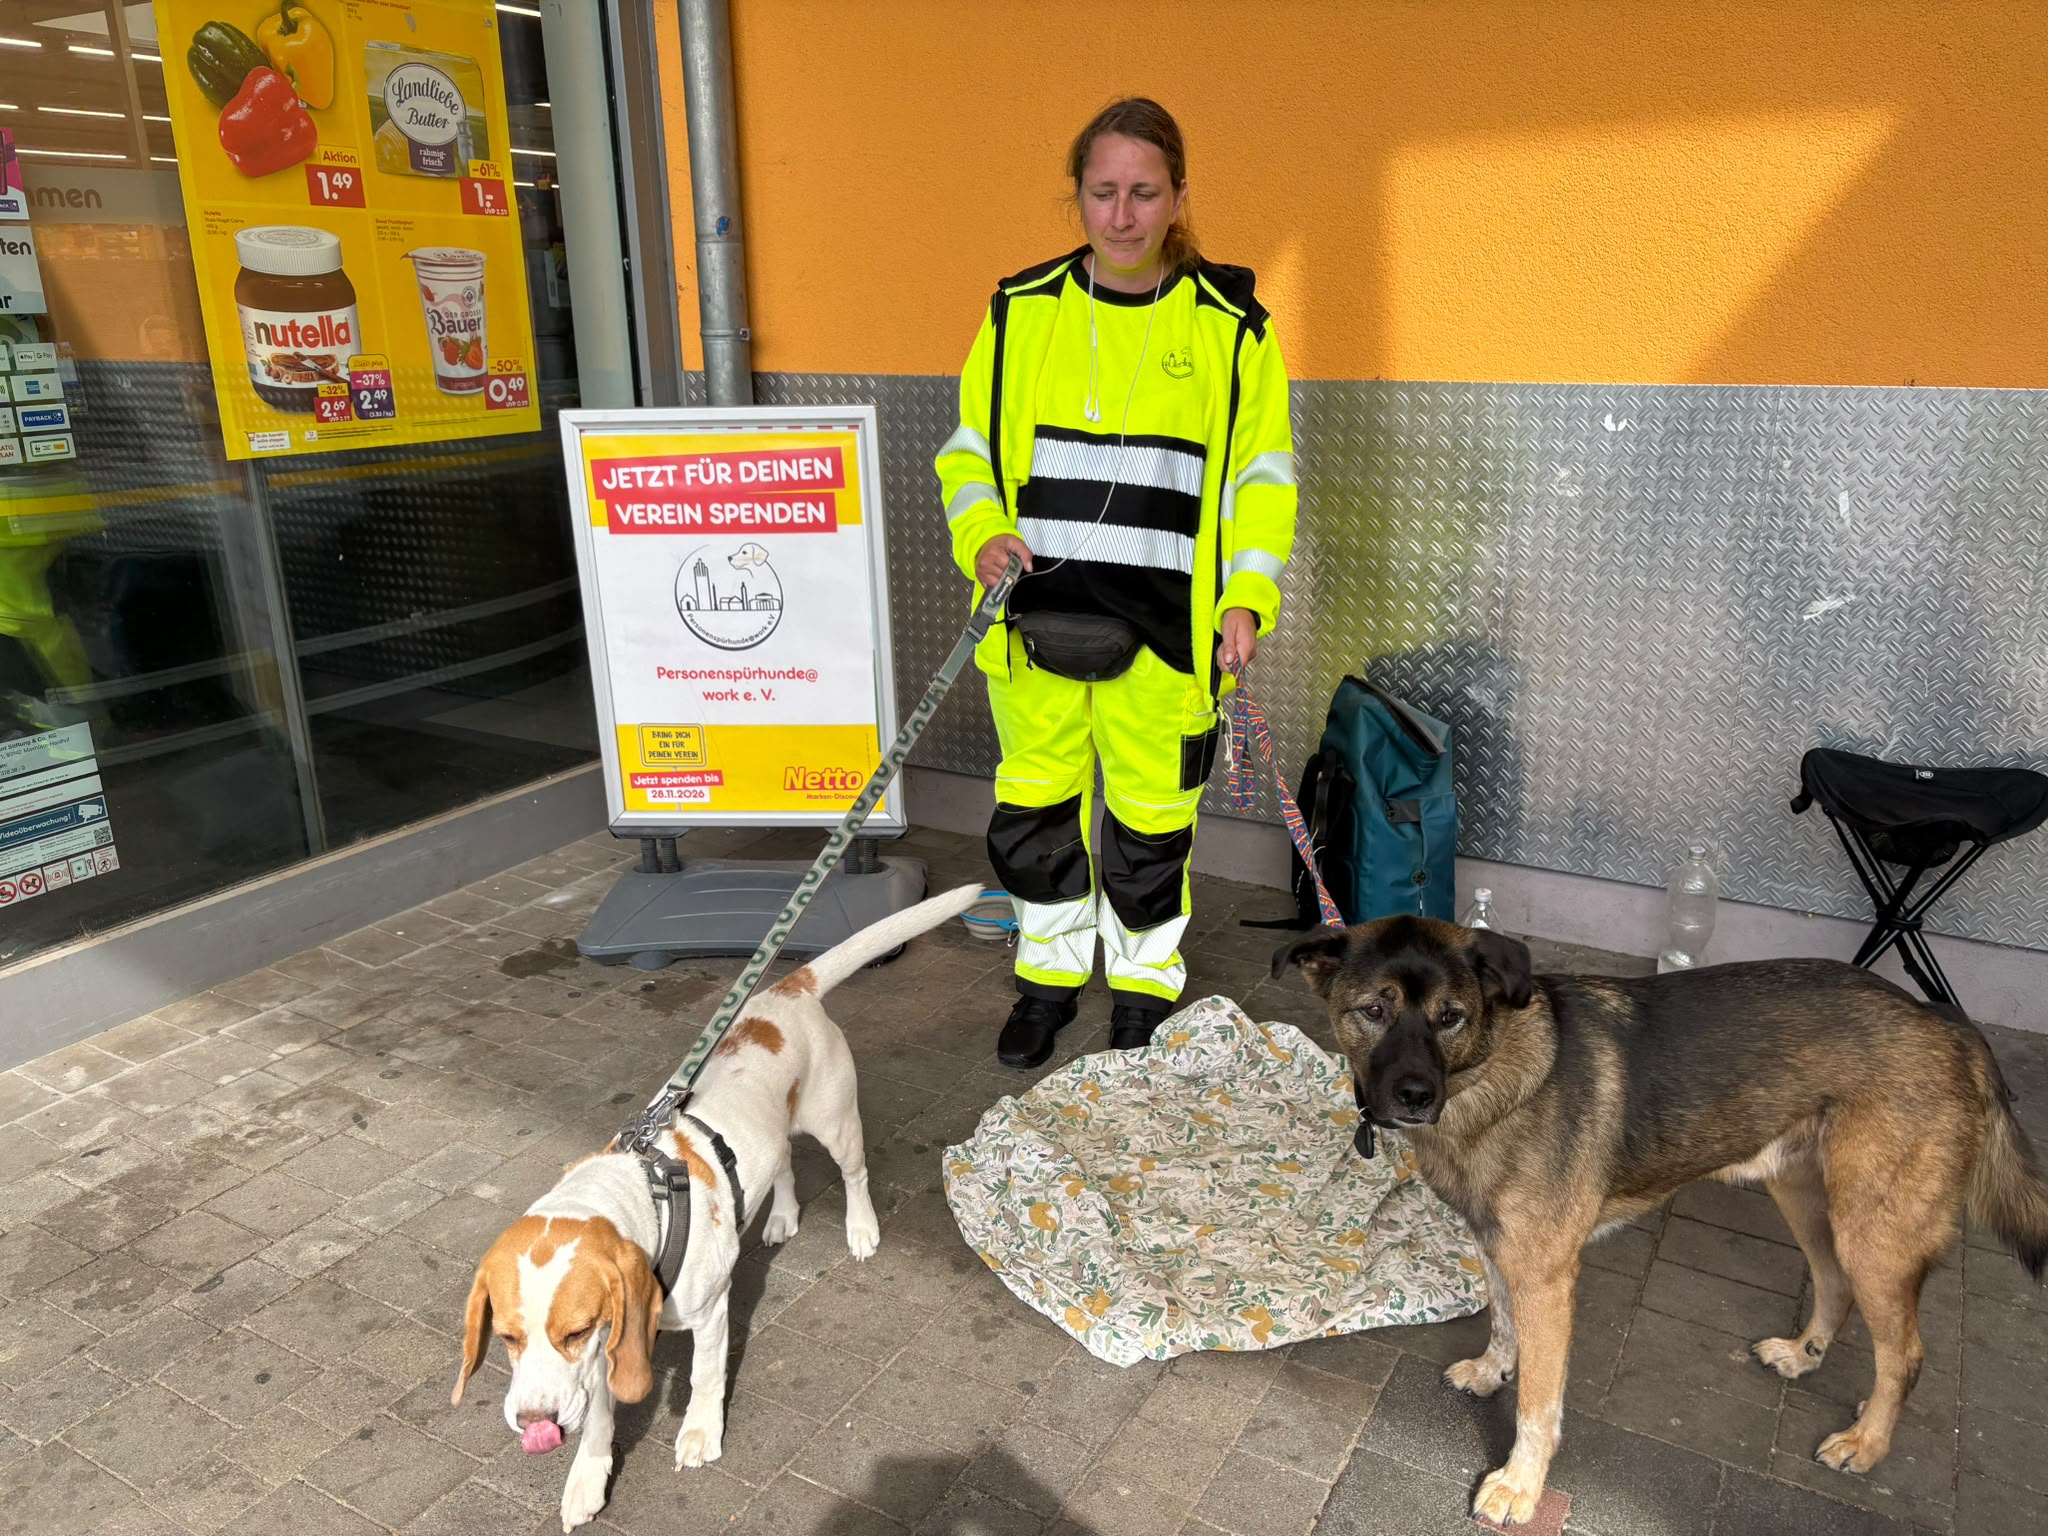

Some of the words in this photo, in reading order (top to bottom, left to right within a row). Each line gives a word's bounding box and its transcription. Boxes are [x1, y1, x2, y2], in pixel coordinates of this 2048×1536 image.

[392, 77, 459, 116] Landliebe
[405, 108, 450, 129] Butter
[323, 150, 357, 164] Aktion
[419, 148, 446, 159] rahmig-
[422, 156, 443, 167] frisch
[472, 163, 500, 178] -61%
[317, 172, 352, 200] 1.49
[426, 308, 482, 336] Bauer
[254, 315, 351, 348] nutella
[490, 360, 523, 373] -50%
[489, 377, 525, 403] 0.49
[359, 389, 388, 410] 2.49
[321, 401, 346, 417] 2.69
[25, 414, 52, 423] PAYBACK
[602, 465, 678, 490] JETZT
[684, 458, 733, 486] FÜR
[739, 457, 834, 484] DEINEN
[615, 503, 703, 525] VEREIN
[709, 502, 826, 525] SPENDEN
[656, 666, 819, 683] Personenspürhunde@
[702, 688, 739, 701] work
[743, 691, 757, 701] e.
[760, 688, 776, 701] V.
[652, 731, 672, 739] BRING
[675, 731, 691, 739] DICH
[8, 741, 31, 750] Stiftung
[659, 741, 671, 749] EIN
[672, 740, 685, 749] FÜR
[648, 751, 672, 759] DEINEN
[673, 750, 698, 759] VEREIN
[634, 775, 658, 786] Jetzt
[661, 773, 702, 785] spenden
[704, 773, 720, 784] bis
[784, 766, 863, 791] Netto
[651, 789, 705, 799] 28.11.2026
[806, 793, 858, 801] Marken-Discou
